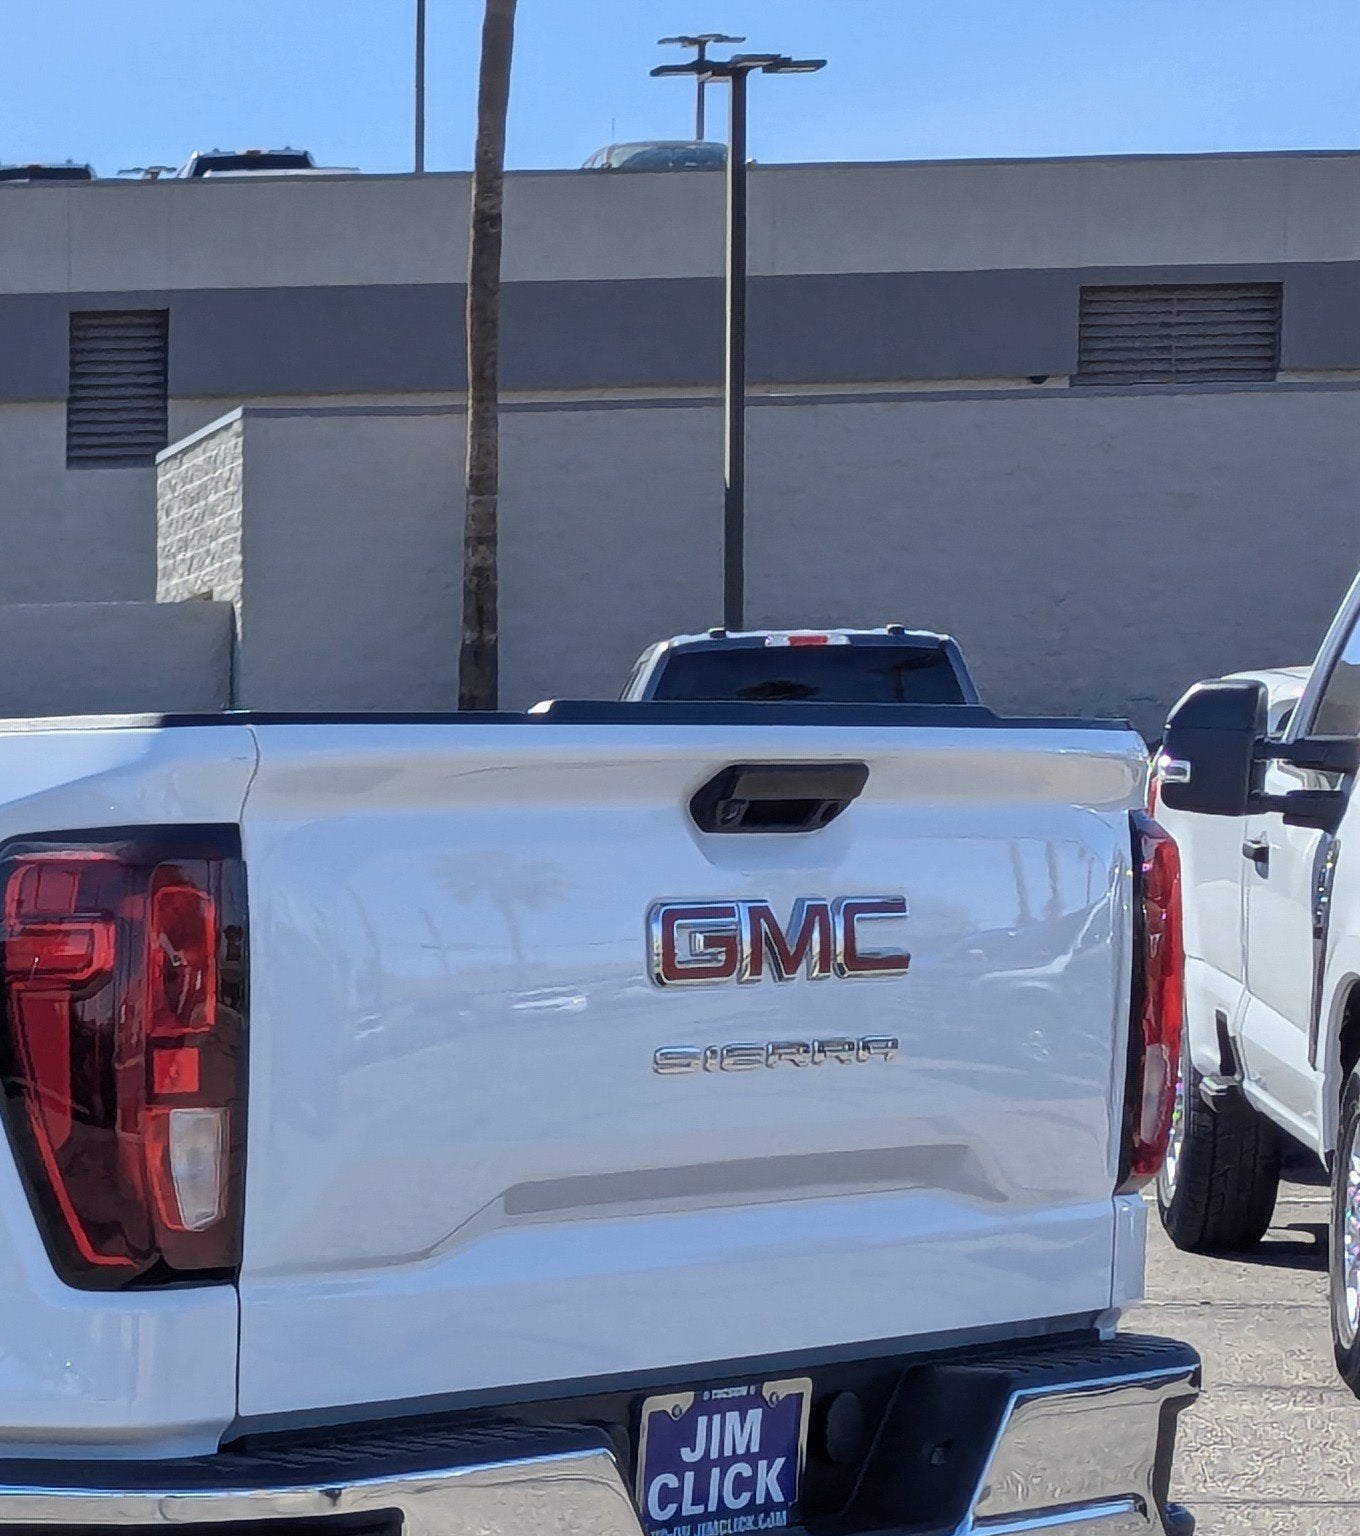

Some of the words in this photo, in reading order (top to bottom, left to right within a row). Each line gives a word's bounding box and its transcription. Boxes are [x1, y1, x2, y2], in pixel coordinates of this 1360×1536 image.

[646, 895, 911, 988] GMC
[653, 1035, 899, 1075] SIERRA
[680, 1408, 763, 1463] JIM
[647, 1457, 787, 1521] CLICK
